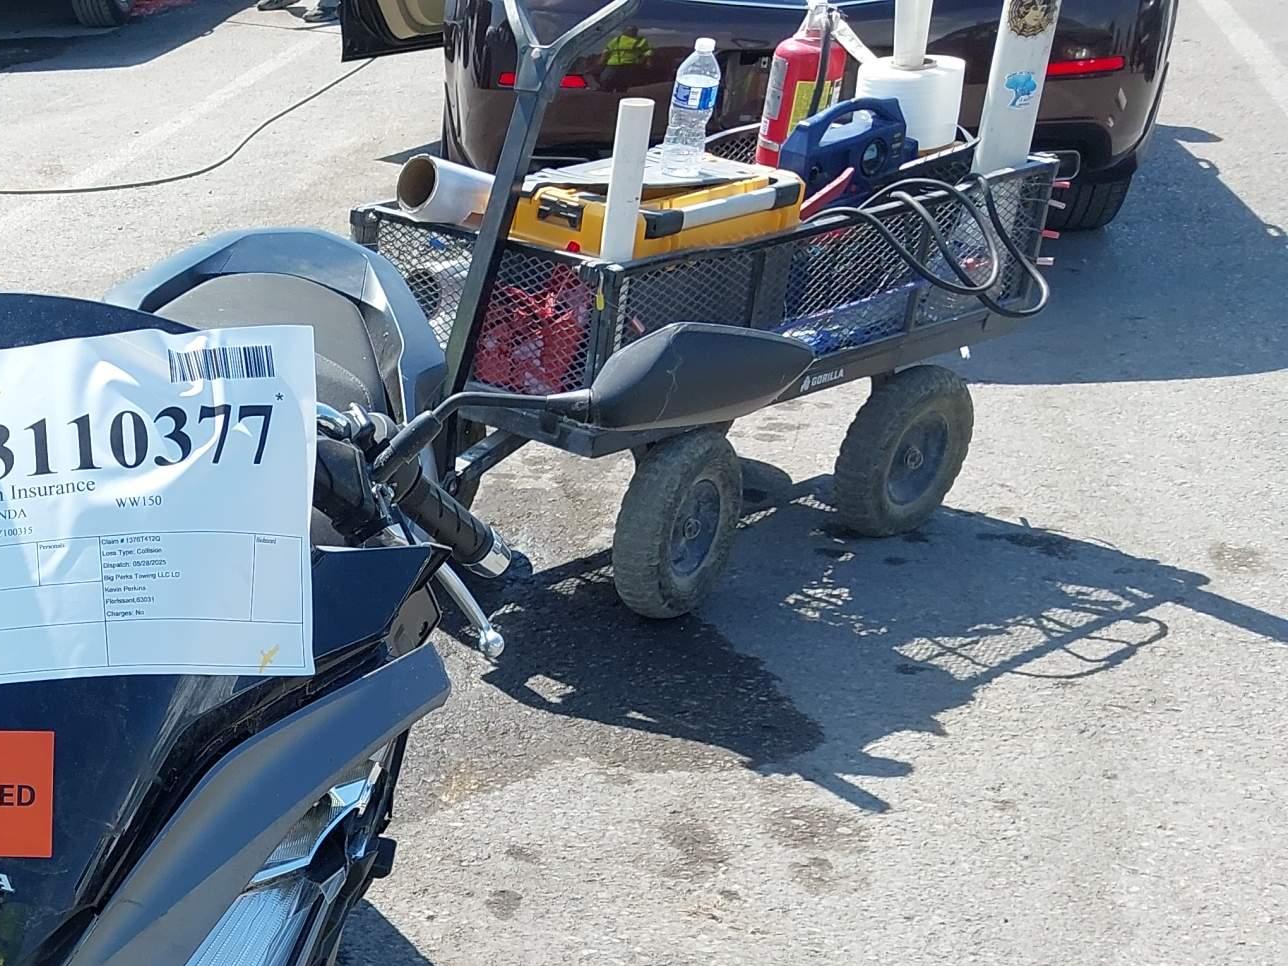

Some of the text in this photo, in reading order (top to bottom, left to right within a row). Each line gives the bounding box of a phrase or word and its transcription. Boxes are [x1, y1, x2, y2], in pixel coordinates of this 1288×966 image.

[811, 367, 844, 386] GORILLA
[11, 480, 96, 500] Insurance
[115, 495, 162, 508] WW150
[136, 547, 162, 555] Collision
[134, 572, 157, 580] Towing
